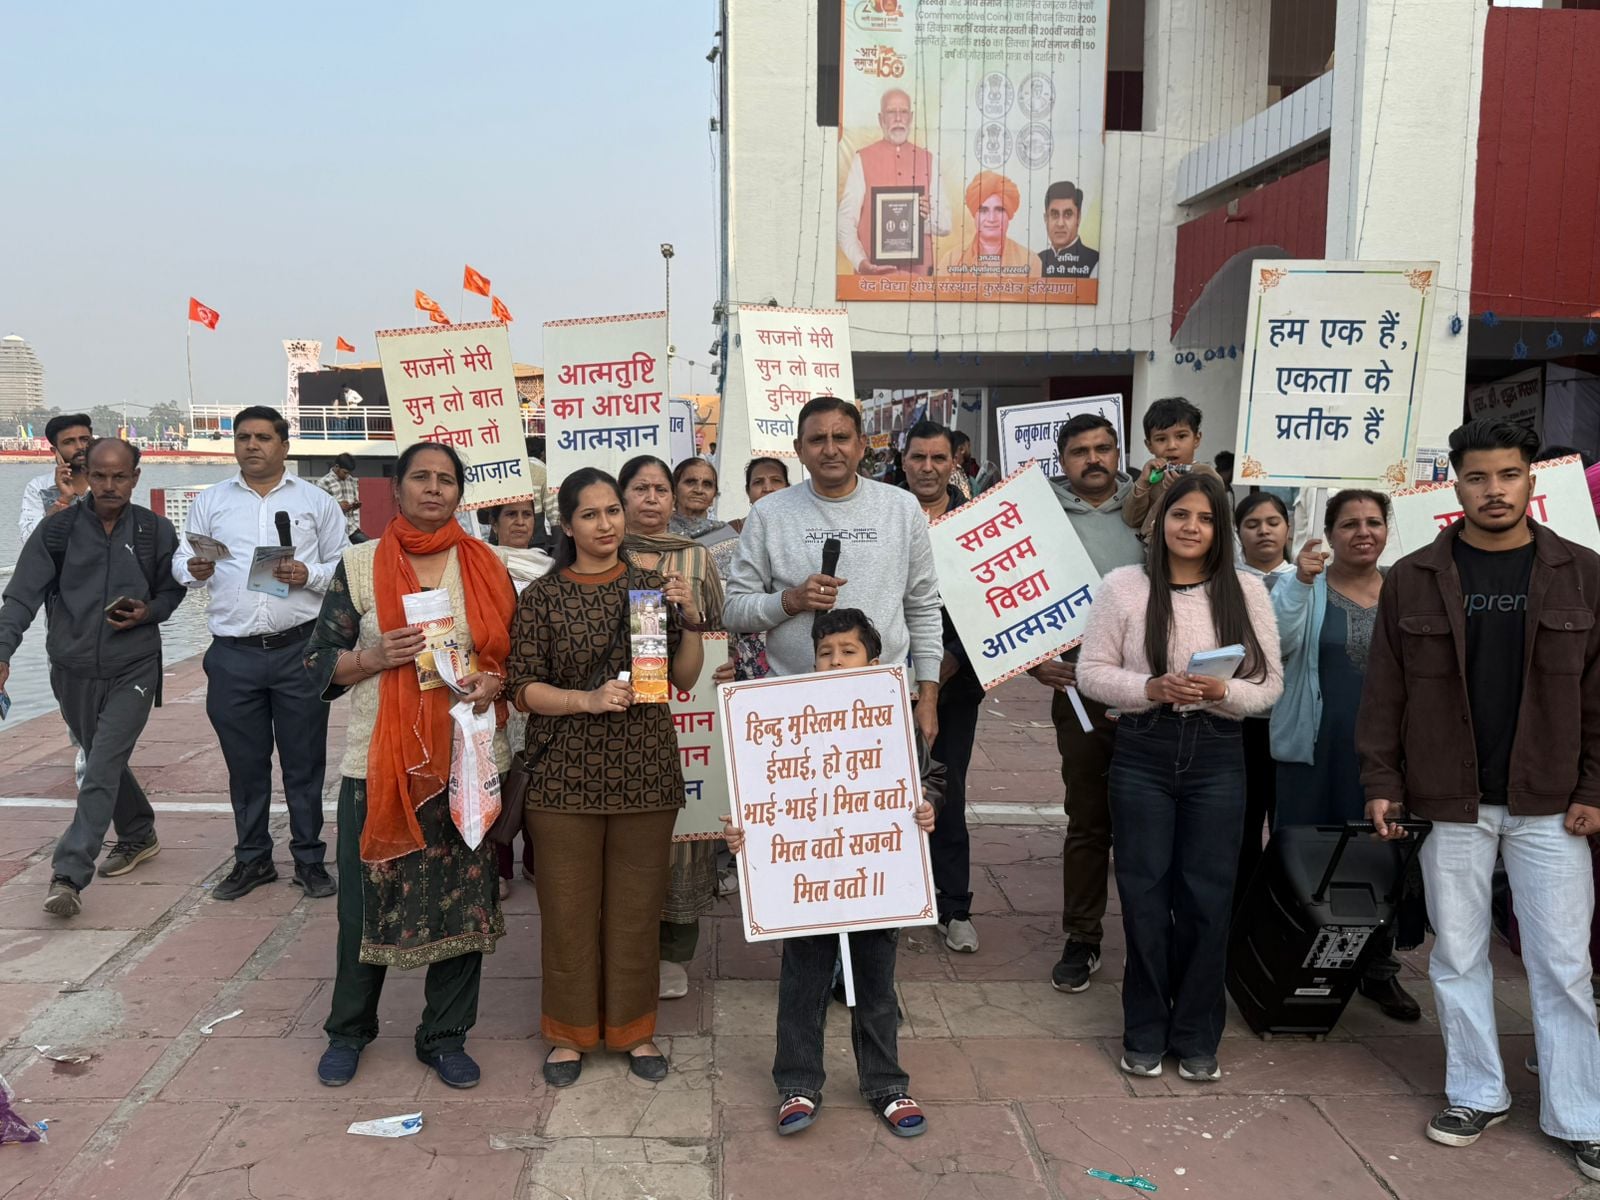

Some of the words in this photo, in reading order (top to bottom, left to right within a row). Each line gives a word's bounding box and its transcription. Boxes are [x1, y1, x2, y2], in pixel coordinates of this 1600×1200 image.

[915, 8, 985, 21] (Commemorative
[986, 12, 1012, 22] Coins)
[999, 24, 1027, 34] सरस्वती
[1082, 41, 1096, 50] 150
[860, 278, 877, 292] वेद
[880, 277, 908, 292] विद्या
[911, 278, 936, 292] शोध
[938, 279, 978, 293] संस्थान
[1027, 280, 1074, 295] हरियाणा
[756, 325, 802, 347] सजनों
[806, 327, 833, 349] मेरी
[1268, 318, 1309, 347] हम
[1320, 319, 1366, 348] एक
[1378, 310, 1408, 350] हैं,
[399, 347, 455, 379] सजनों
[460, 344, 494, 373] मेरी
[557, 351, 656, 389] आत्मतुष्टि
[755, 358, 781, 381] सुन
[787, 354, 807, 376] लो
[812, 362, 839, 379] बात
[1276, 367, 1352, 395] एकता
[1364, 360, 1393, 394] के
[402, 396, 435, 426] सुन
[439, 386, 464, 413] लो
[468, 387, 504, 409] बात
[551, 398, 584, 421] का
[591, 391, 663, 417] आधार
[765, 384, 811, 412] दुनिया
[478, 418, 500, 445] तों
[557, 424, 659, 452] आत्मज्ञान
[754, 414, 795, 438] राहवो
[1014, 421, 1052, 450] कलुकाल
[1275, 407, 1352, 441] प्रतीक
[1363, 407, 1385, 444] हैं
[805, 531, 878, 540] AUTHENTIC
[955, 501, 1023, 552] सबसे
[970, 535, 1037, 584] उत्तम
[985, 568, 1050, 618] विद्या
[982, 583, 1094, 659] आत्मज्ञान
[745, 711, 784, 747] हिन्दु
[788, 704, 848, 745] मुस्लिम
[852, 698, 894, 729] सिख
[766, 746, 817, 785] ईसाई,
[822, 744, 842, 779] हो
[845, 738, 883, 781] तुसां
[833, 784, 870, 816] मिल
[771, 833, 809, 864] मिल
[849, 822, 903, 855] सजनो
[793, 873, 830, 904] मिल
